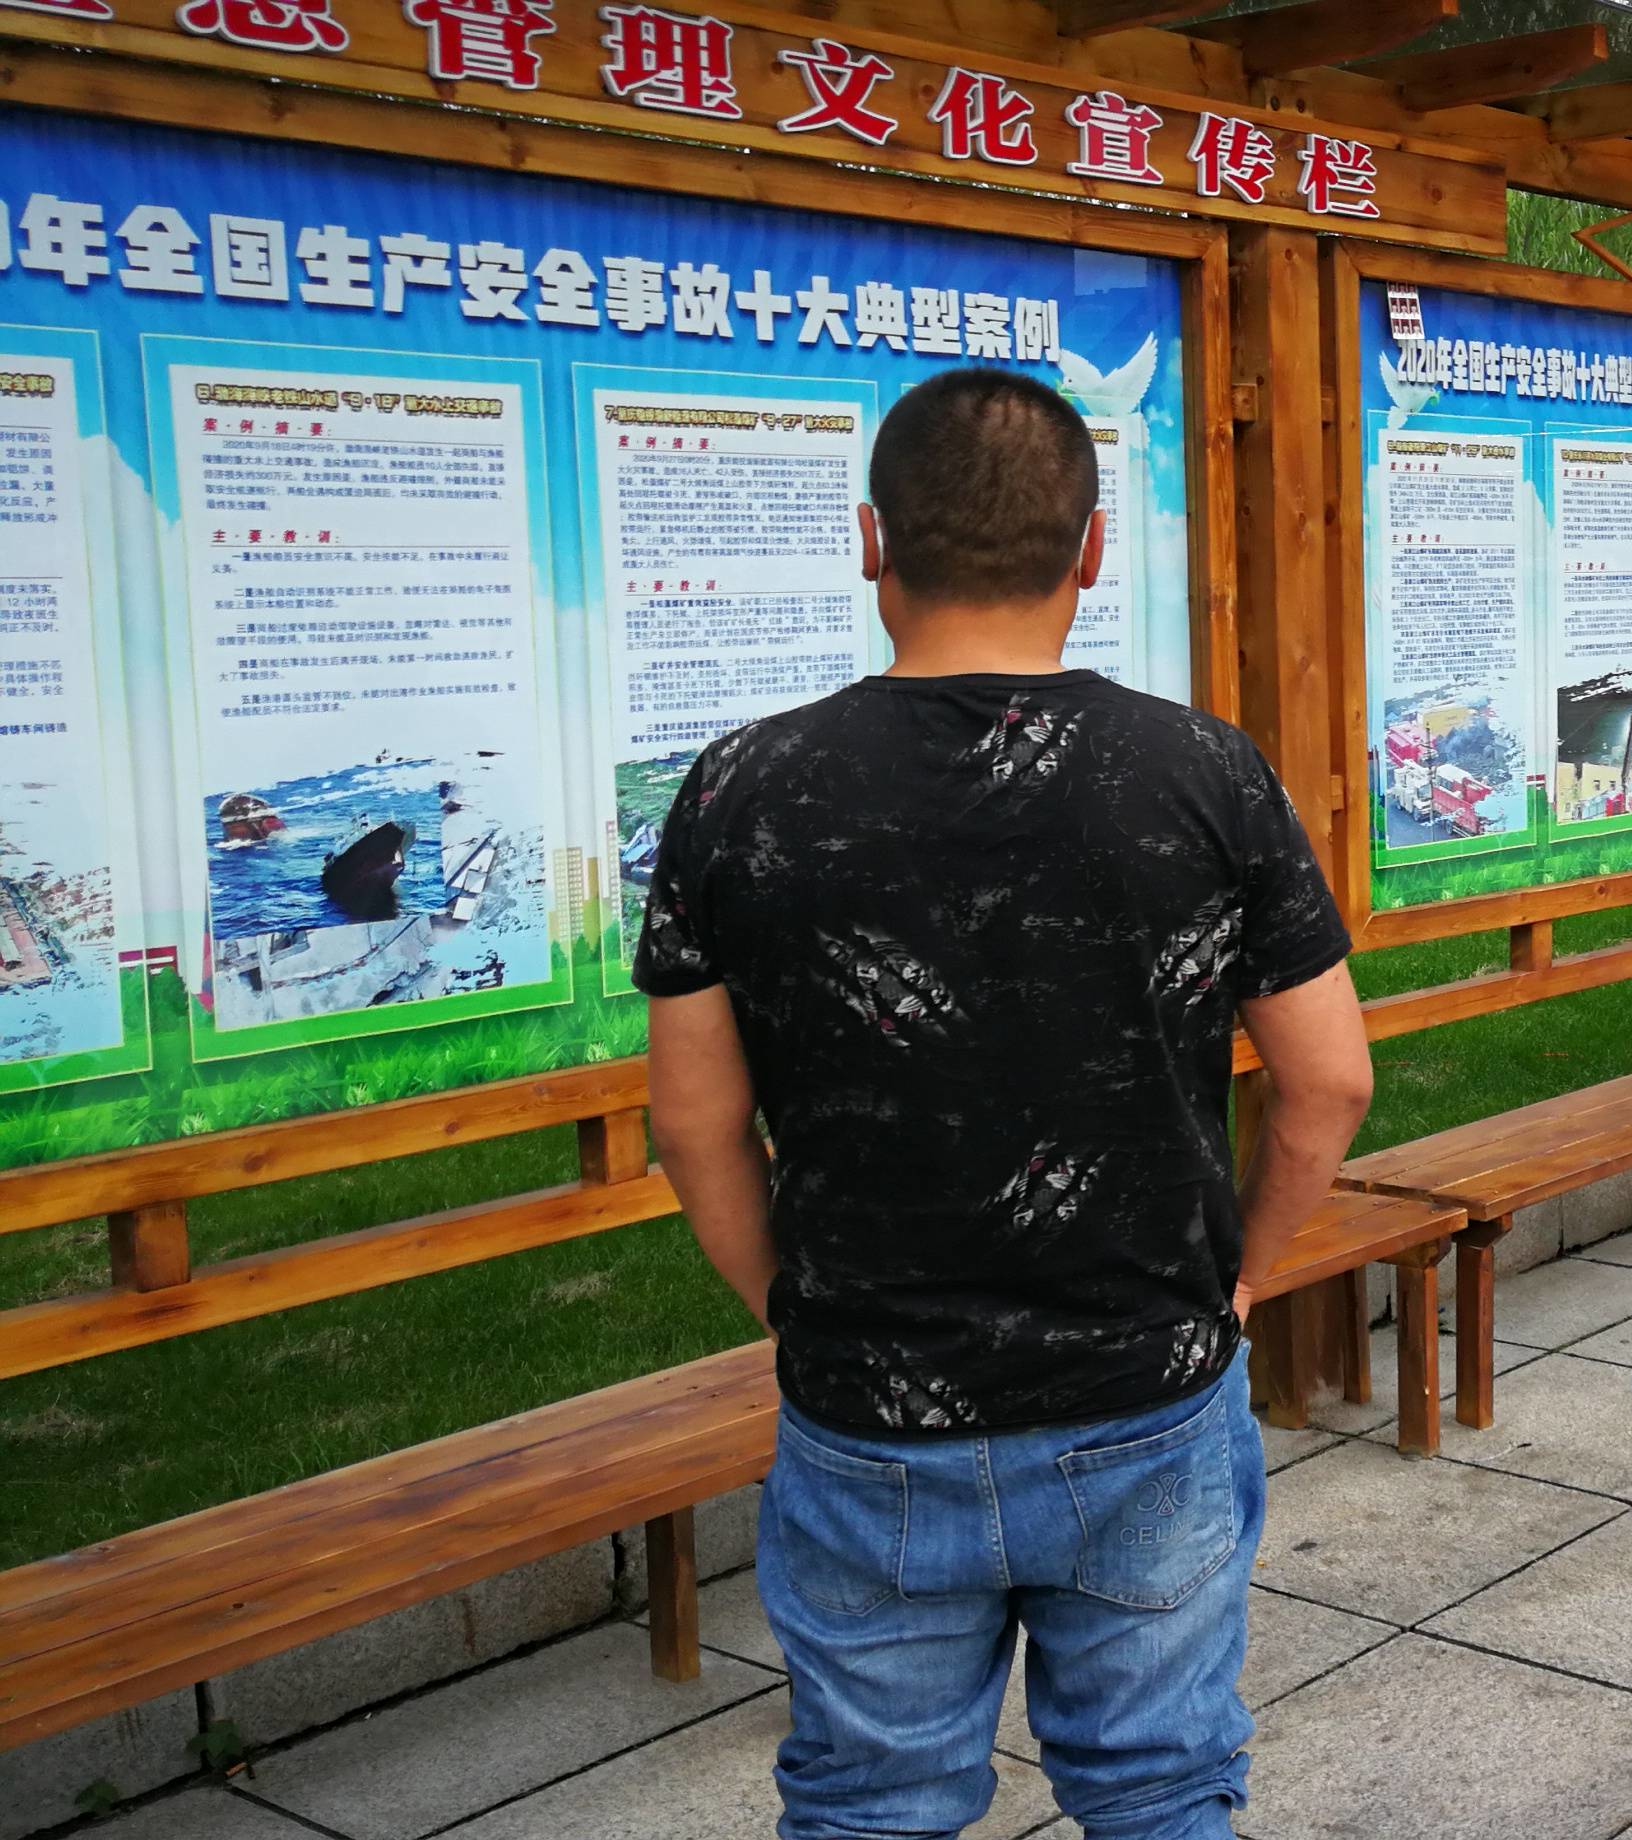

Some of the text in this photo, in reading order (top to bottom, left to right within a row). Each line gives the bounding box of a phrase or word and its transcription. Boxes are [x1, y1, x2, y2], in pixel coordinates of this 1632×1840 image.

[0, 0, 1382, 218] 管理文化宣传栏
[0, 192, 1061, 365] 年全国生产安全事故十大典型案例
